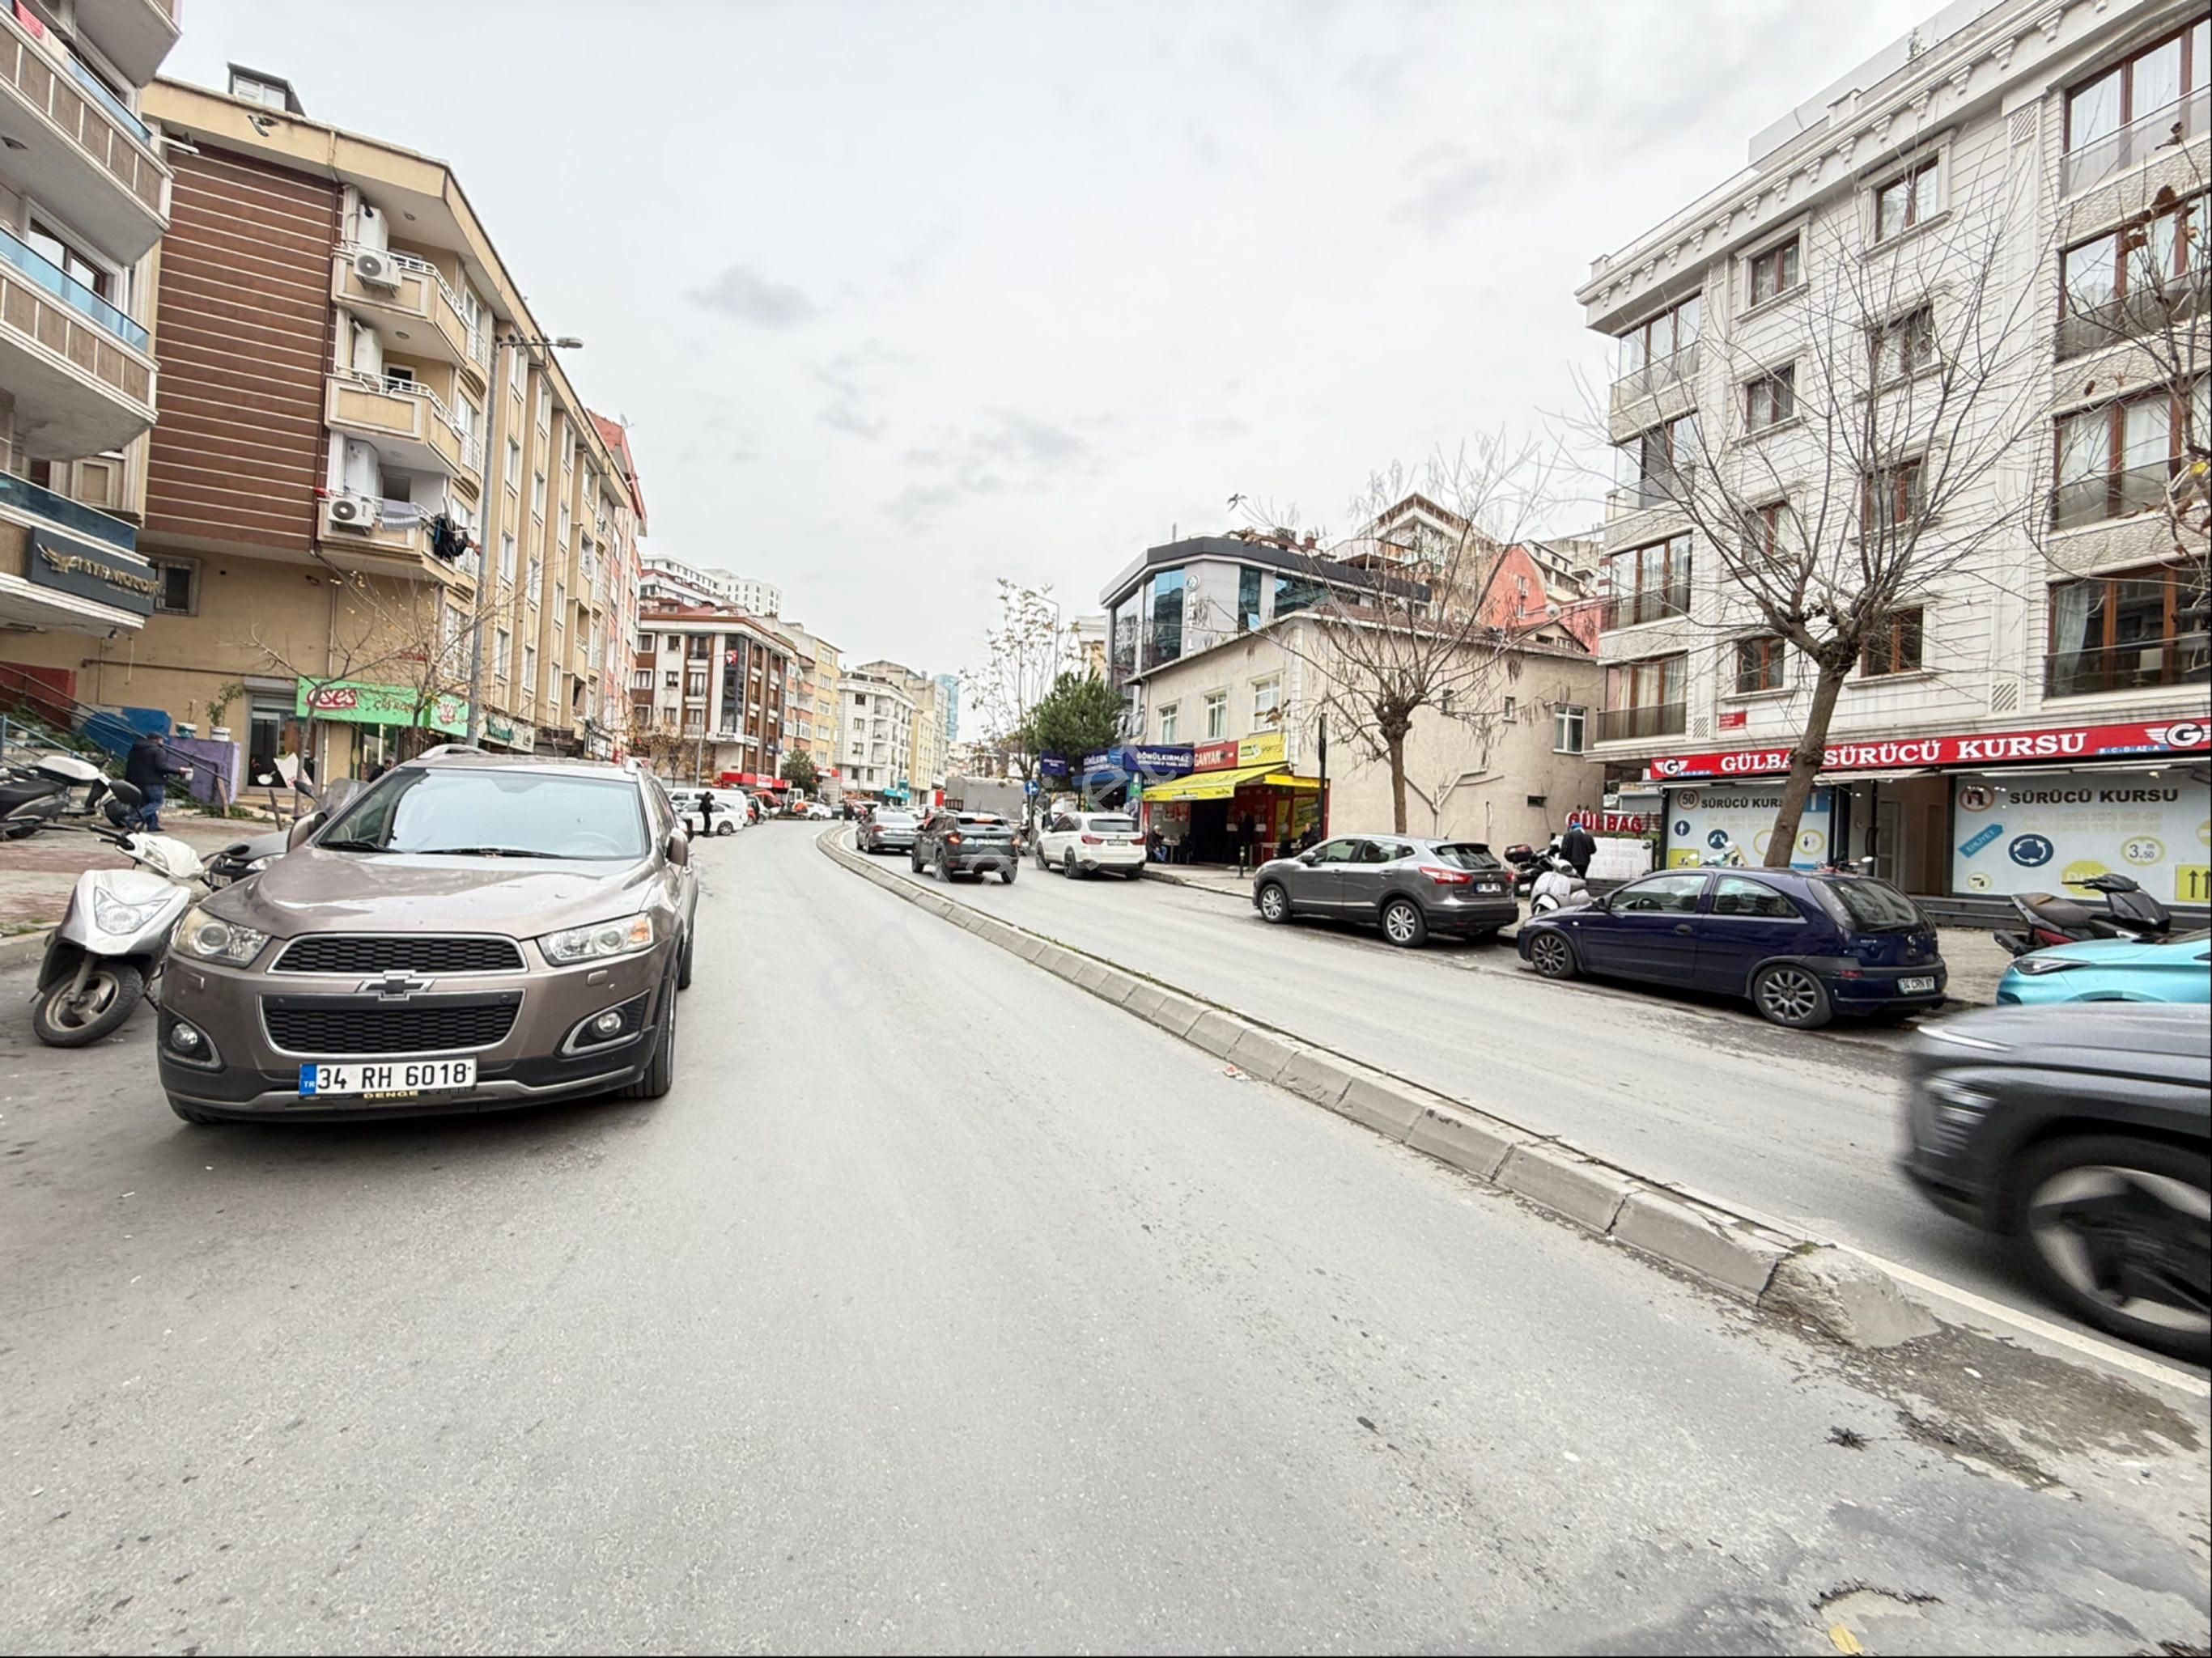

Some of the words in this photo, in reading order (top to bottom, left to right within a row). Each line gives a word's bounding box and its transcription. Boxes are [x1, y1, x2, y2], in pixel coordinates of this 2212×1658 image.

[1195, 750, 1221, 767] GANYAN
[1720, 753, 1792, 773] GÜLBA
[1822, 740, 1942, 766] SÜRÜCÜ
[1956, 732, 2087, 760] KURSU
[1682, 793, 1695, 806] 50
[1700, 797, 1748, 809] SÜRÜCÜ
[2010, 790, 2093, 804] SÜRÜCÜ
[2099, 788, 2179, 804] KURSU
[317, 1067, 347, 1089] 34
[361, 1066, 393, 1089] RH
[405, 1062, 467, 1087] 6018
[363, 1090, 419, 1099] DENGE
